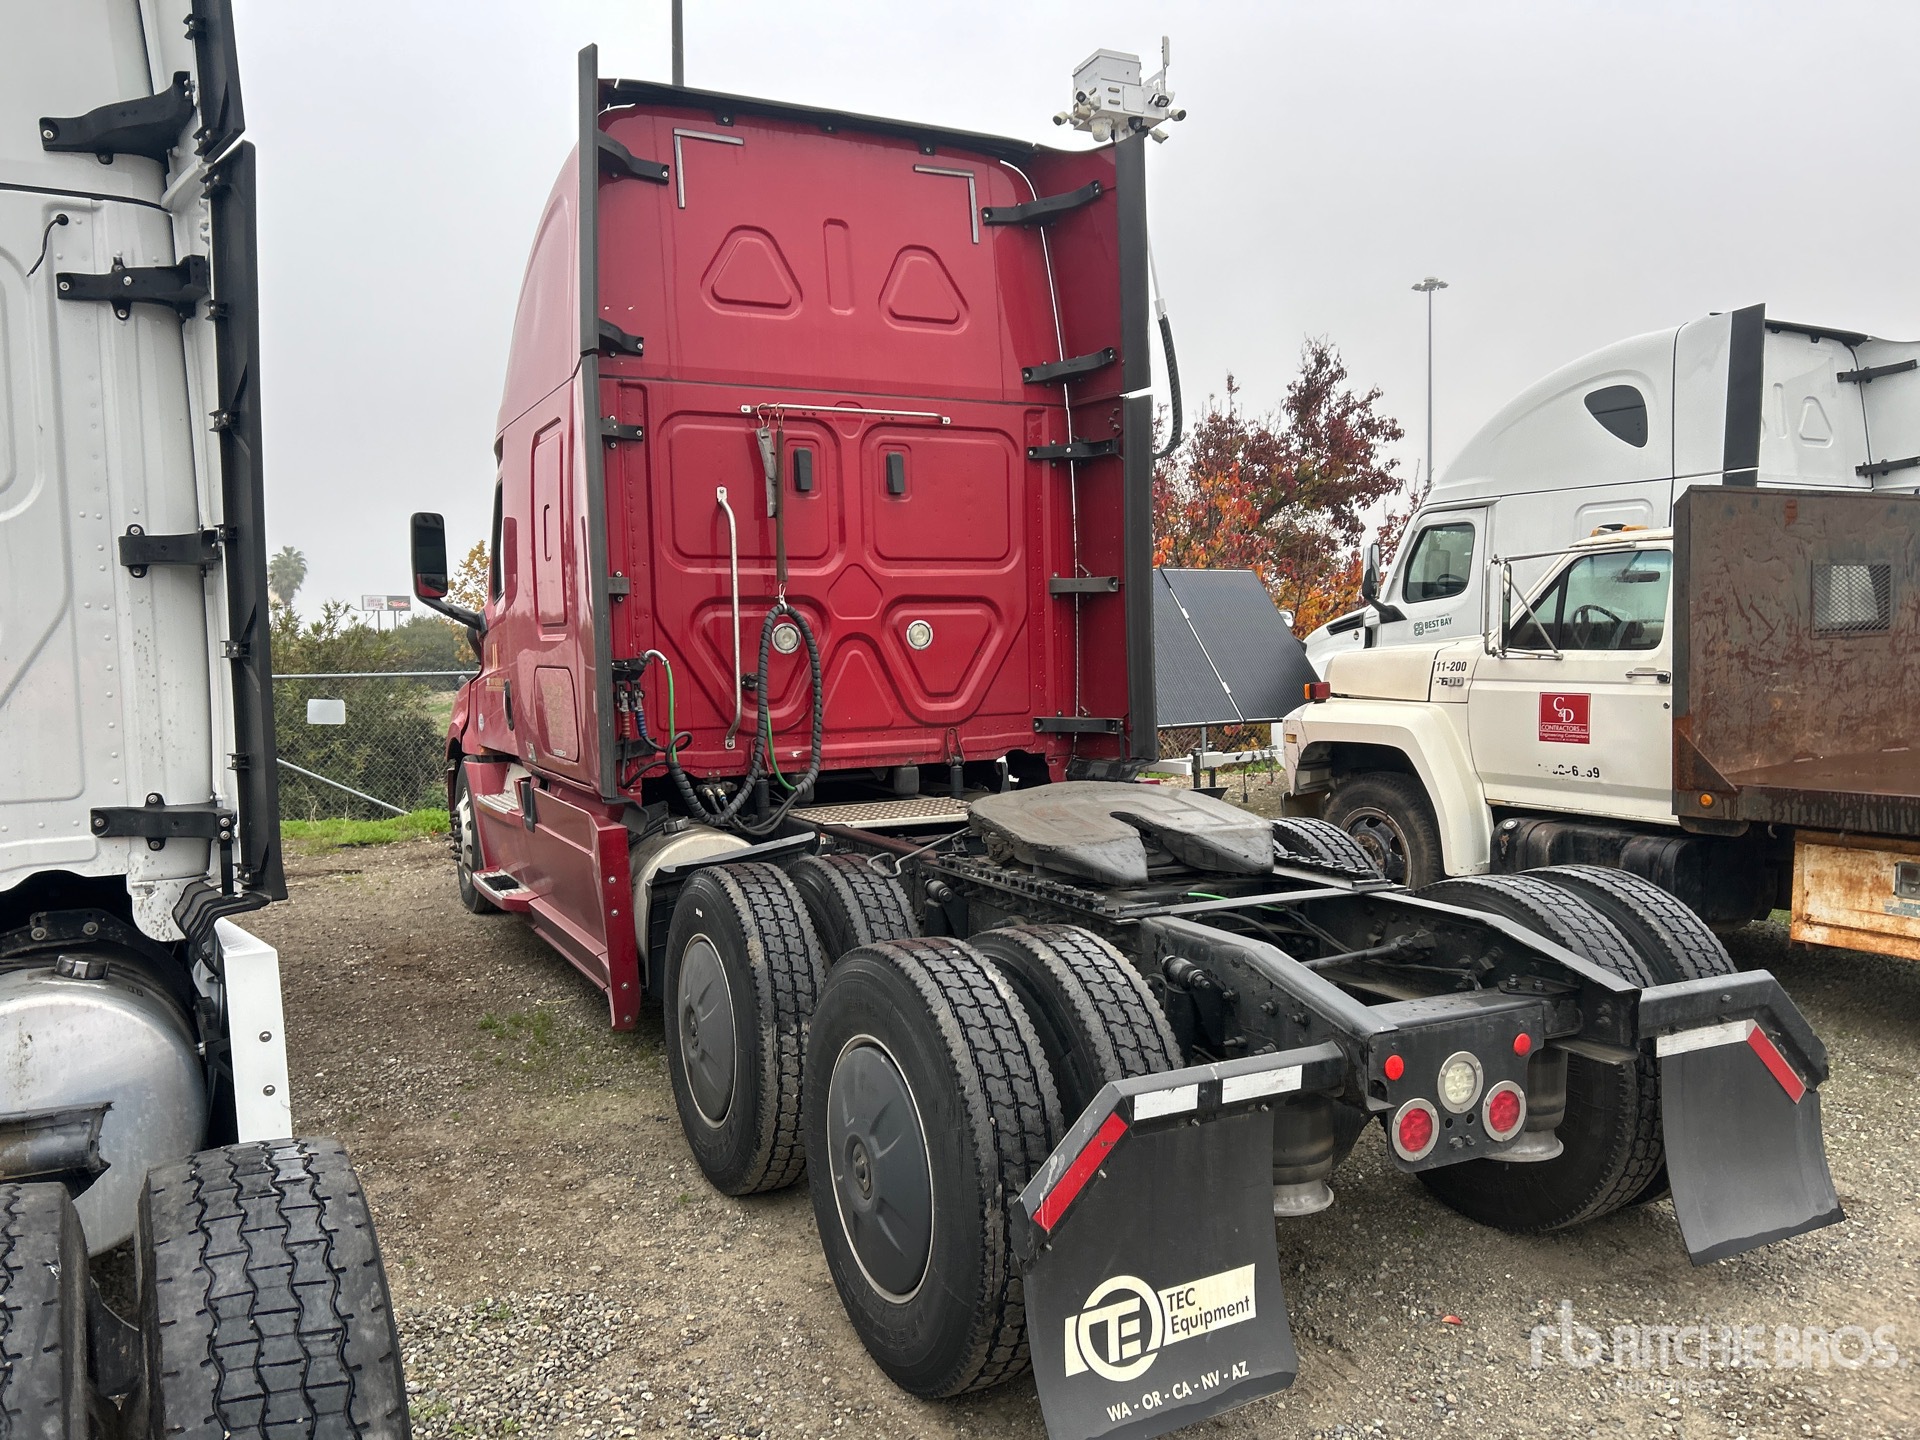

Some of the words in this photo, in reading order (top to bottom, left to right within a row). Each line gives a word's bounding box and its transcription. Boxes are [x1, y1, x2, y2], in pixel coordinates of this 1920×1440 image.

[1425, 620, 1439, 629] BEST
[1440, 617, 1453, 626] BAY
[1436, 661, 1467, 672] 11-200
[1166, 1287, 1196, 1312] TEC
[1171, 1295, 1250, 1336] Equipment
[1106, 1402, 1133, 1422] WA
[1142, 1391, 1163, 1410] OR
[1172, 1381, 1193, 1399] CA
[1200, 1370, 1220, 1390] NV
[1232, 1361, 1250, 1380] AZ
